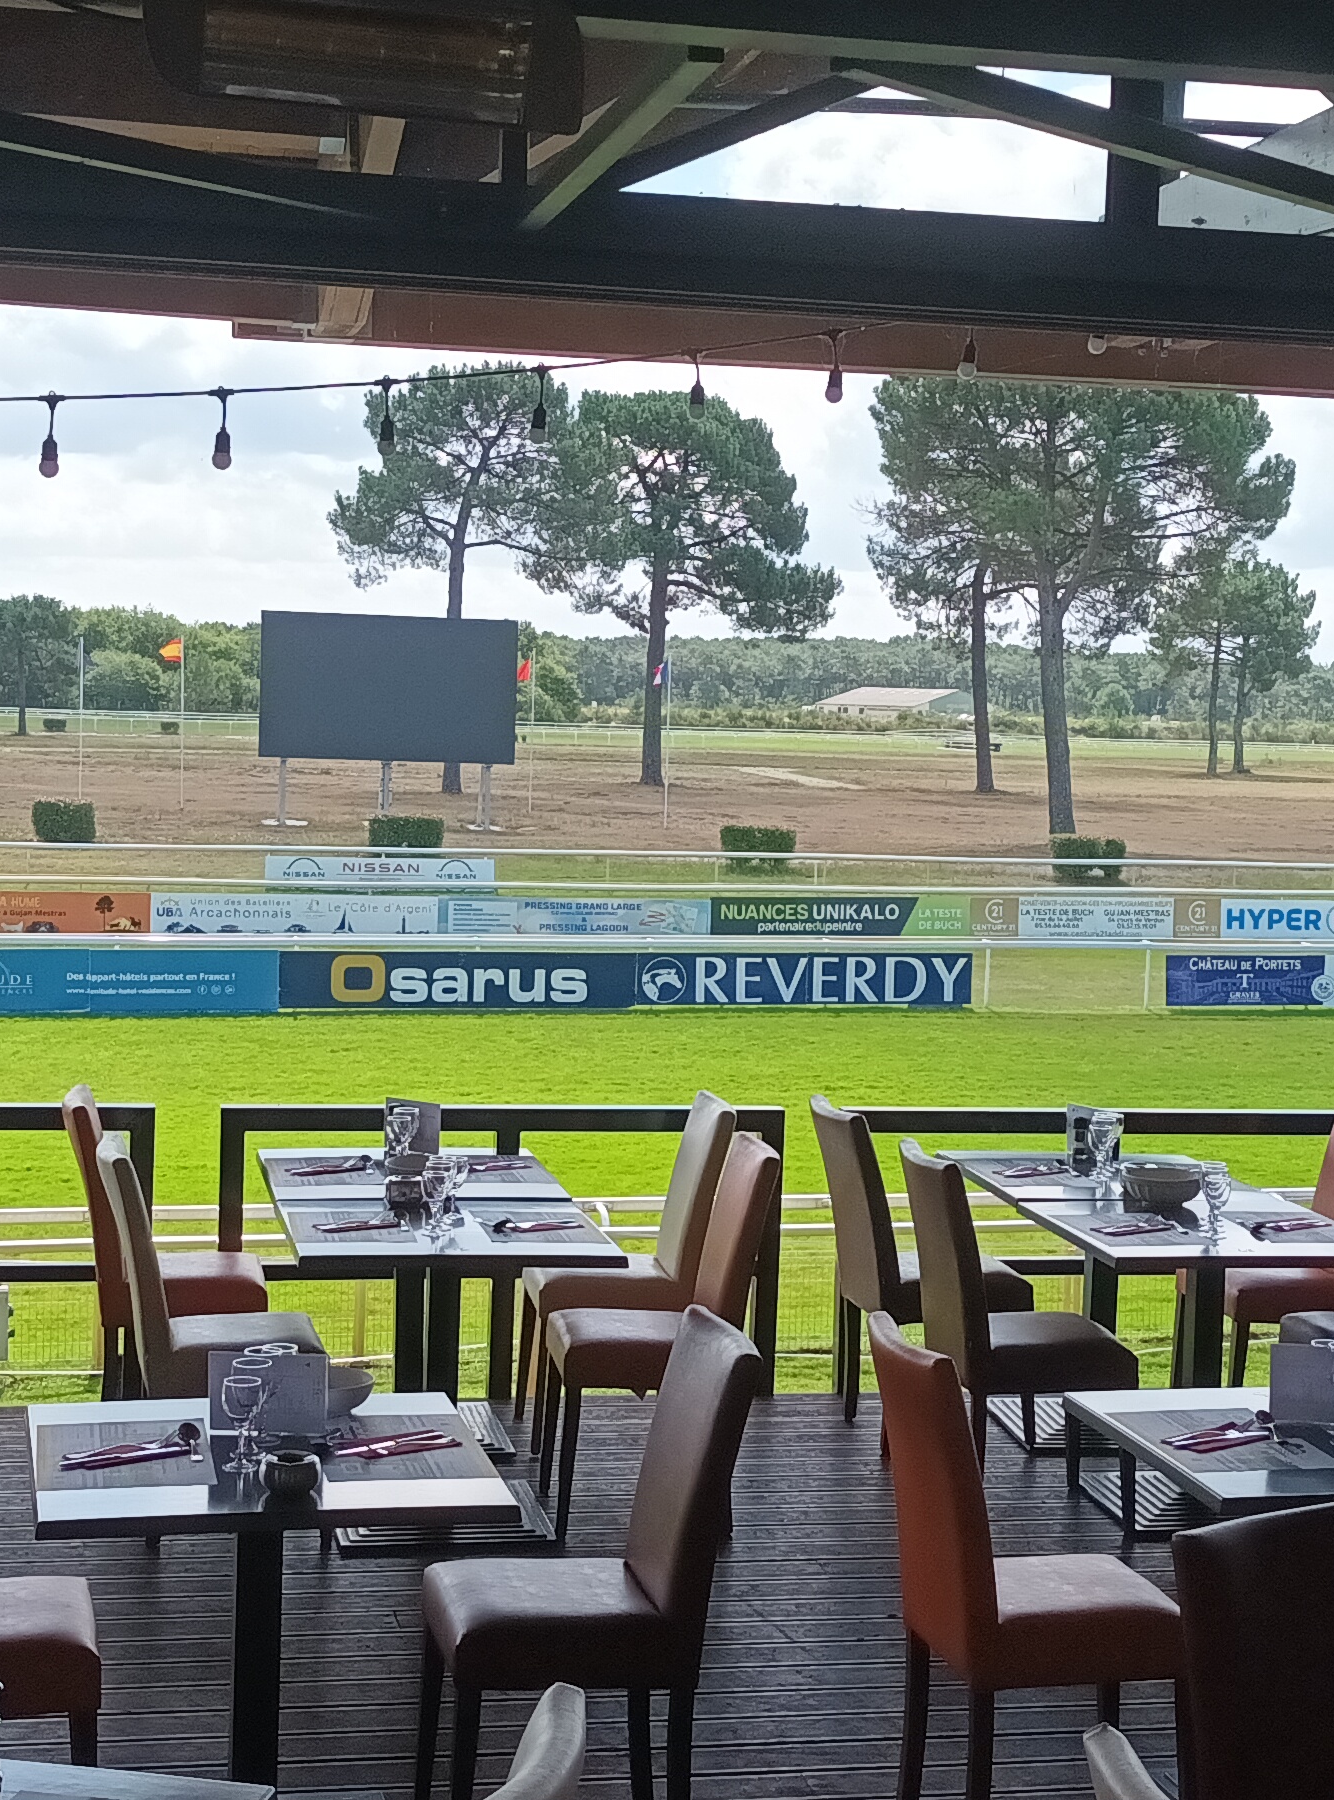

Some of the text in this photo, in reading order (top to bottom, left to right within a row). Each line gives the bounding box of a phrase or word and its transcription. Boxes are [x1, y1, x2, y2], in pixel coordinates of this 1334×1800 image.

[342, 862, 420, 873] NISSAN
[11, 896, 42, 907] HUME
[190, 898, 220, 906] Union
[328, 902, 342, 912] Le
[524, 902, 643, 911] PRESSING GRAND LARGE
[189, 908, 292, 919] Arcachonnais
[720, 904, 900, 920] NUANCES UNIKALO
[919, 908, 962, 918] LA TESTE
[1020, 908, 1031, 916] LA
[919, 920, 962, 930] DE BUCH
[1226, 908, 1322, 931] HYPER
[590, 924, 629, 932] LAGOON
[757, 920, 863, 933] partenairedupeintre
[1189, 956, 1302, 971] CHÂTEAU DE PORTETS
[66, 972, 84, 981] Des
[85, 972, 148, 983] appart-hôtels
[150, 973, 184, 983] partout
[199, 972, 230, 981] France
[330, 954, 588, 1004] Osarus
[695, 956, 972, 1004] REVERDY
